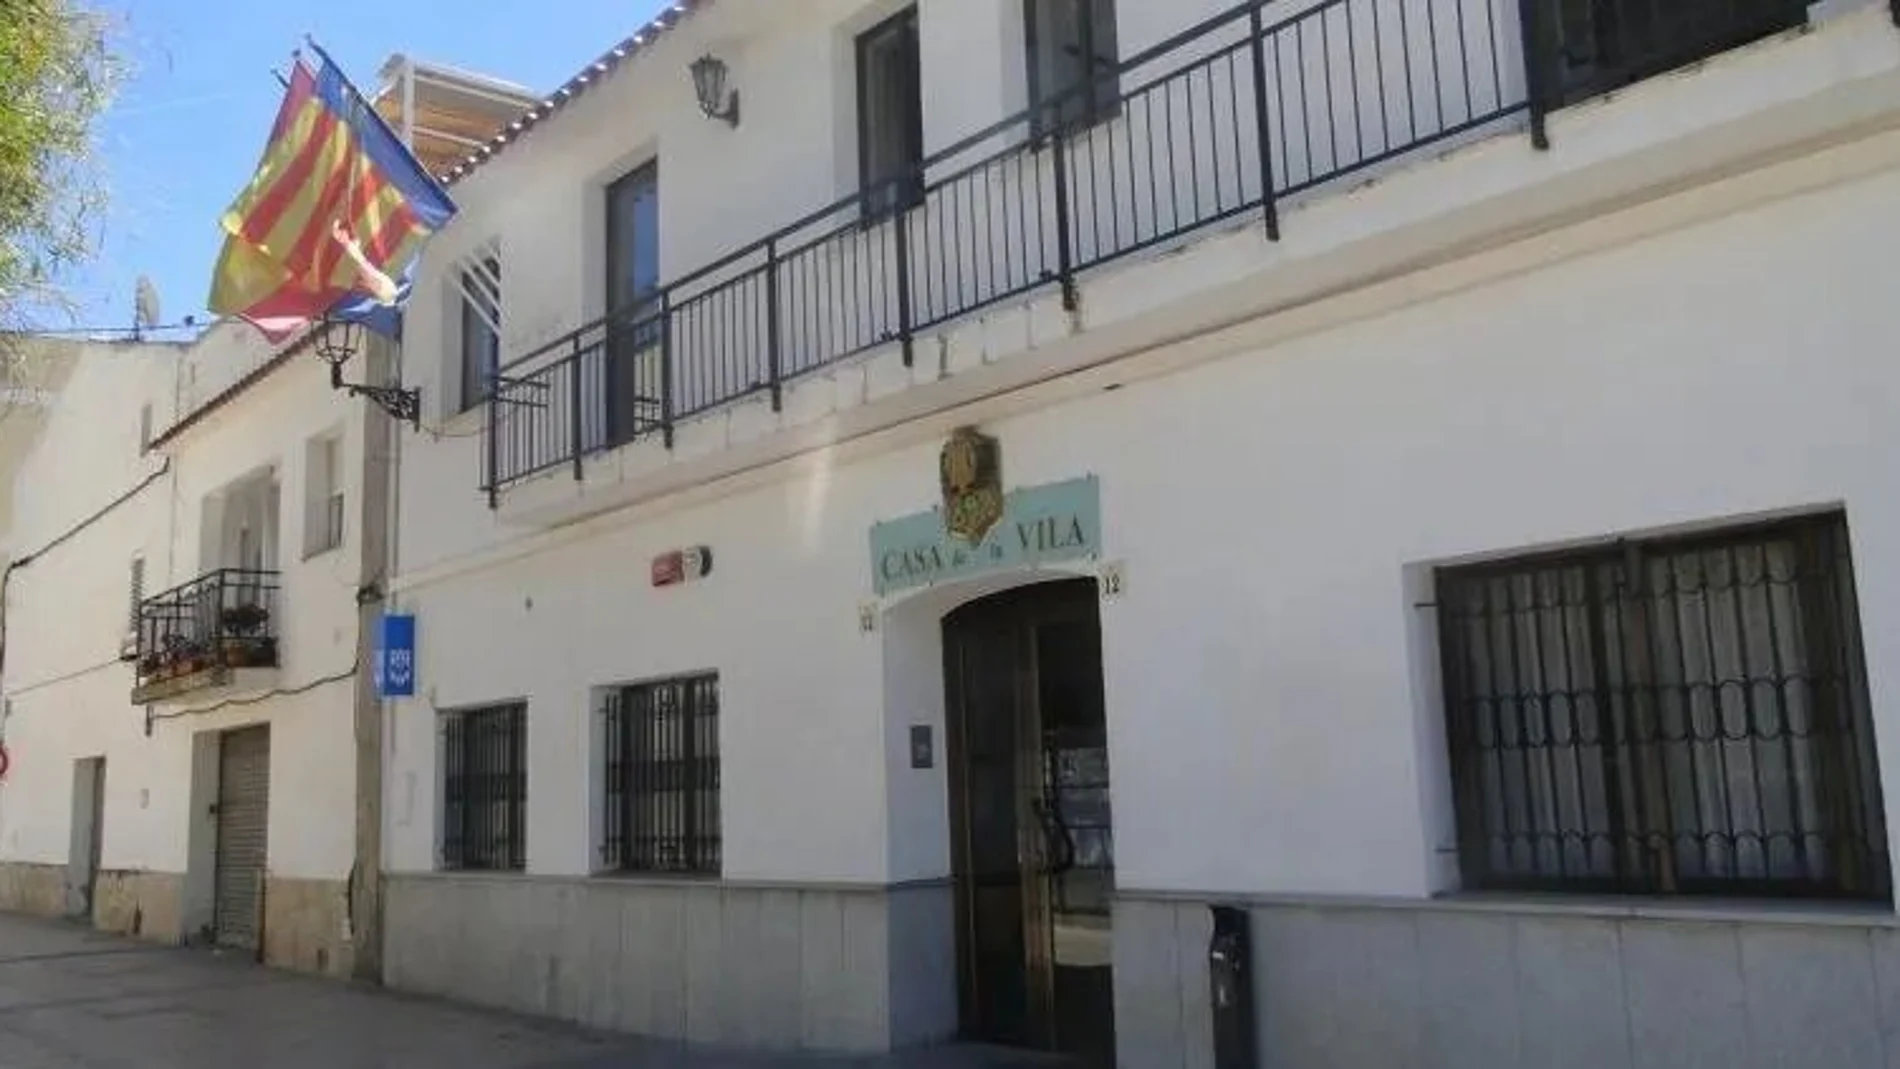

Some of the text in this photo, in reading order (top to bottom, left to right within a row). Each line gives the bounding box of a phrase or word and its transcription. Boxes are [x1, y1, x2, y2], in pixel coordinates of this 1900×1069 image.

[880, 545, 942, 581] CASA
[1015, 512, 1084, 552] VILA
[1104, 573, 1121, 595] 12
